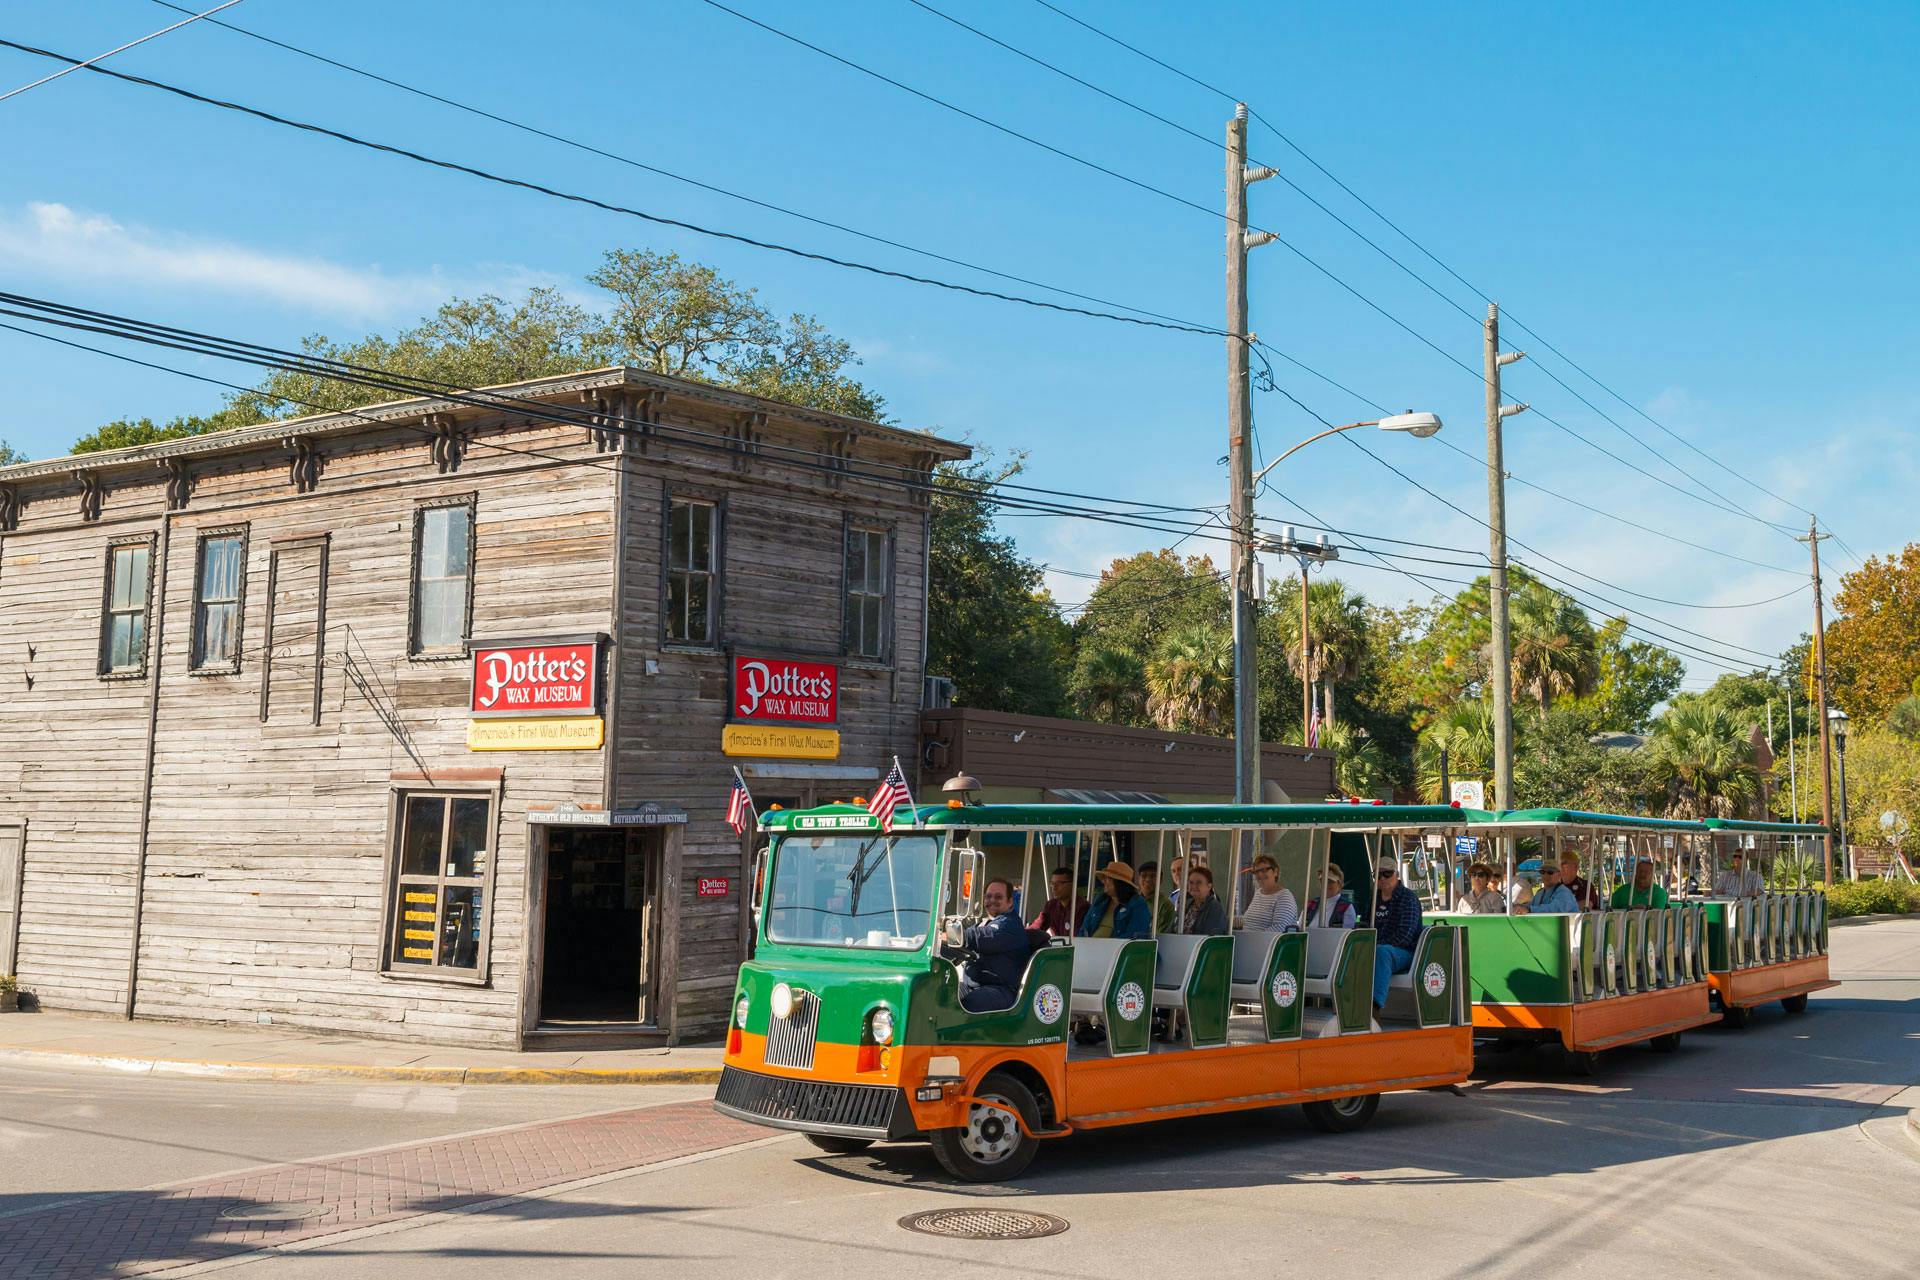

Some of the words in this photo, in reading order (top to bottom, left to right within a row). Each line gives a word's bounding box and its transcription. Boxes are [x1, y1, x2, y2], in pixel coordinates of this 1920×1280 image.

[479, 652, 586, 707] Potter's
[506, 688, 530, 703] WAX
[535, 686, 582, 703] MUSEUM
[740, 662, 832, 715] Potter's
[765, 699, 786, 714] WAX
[790, 700, 829, 717] MUSEUM
[473, 725, 516, 741] America's
[518, 725, 537, 738] First
[540, 725, 558, 738] Wax
[560, 724, 595, 738] Museum
[729, 732, 767, 747] America's
[769, 734, 786, 746] First
[788, 735, 804, 748] Wax
[805, 735, 834, 749] Museum
[559, 813, 571, 822] OLD
[613, 814, 644, 824] AUTHENTIC
[645, 814, 656, 823] OLD
[802, 817, 815, 827] OLD
[817, 817, 837, 827] TOWN
[839, 816, 870, 827] TROLLEY
[1045, 833, 1063, 845] ATM
[700, 879, 727, 894] Potter's
